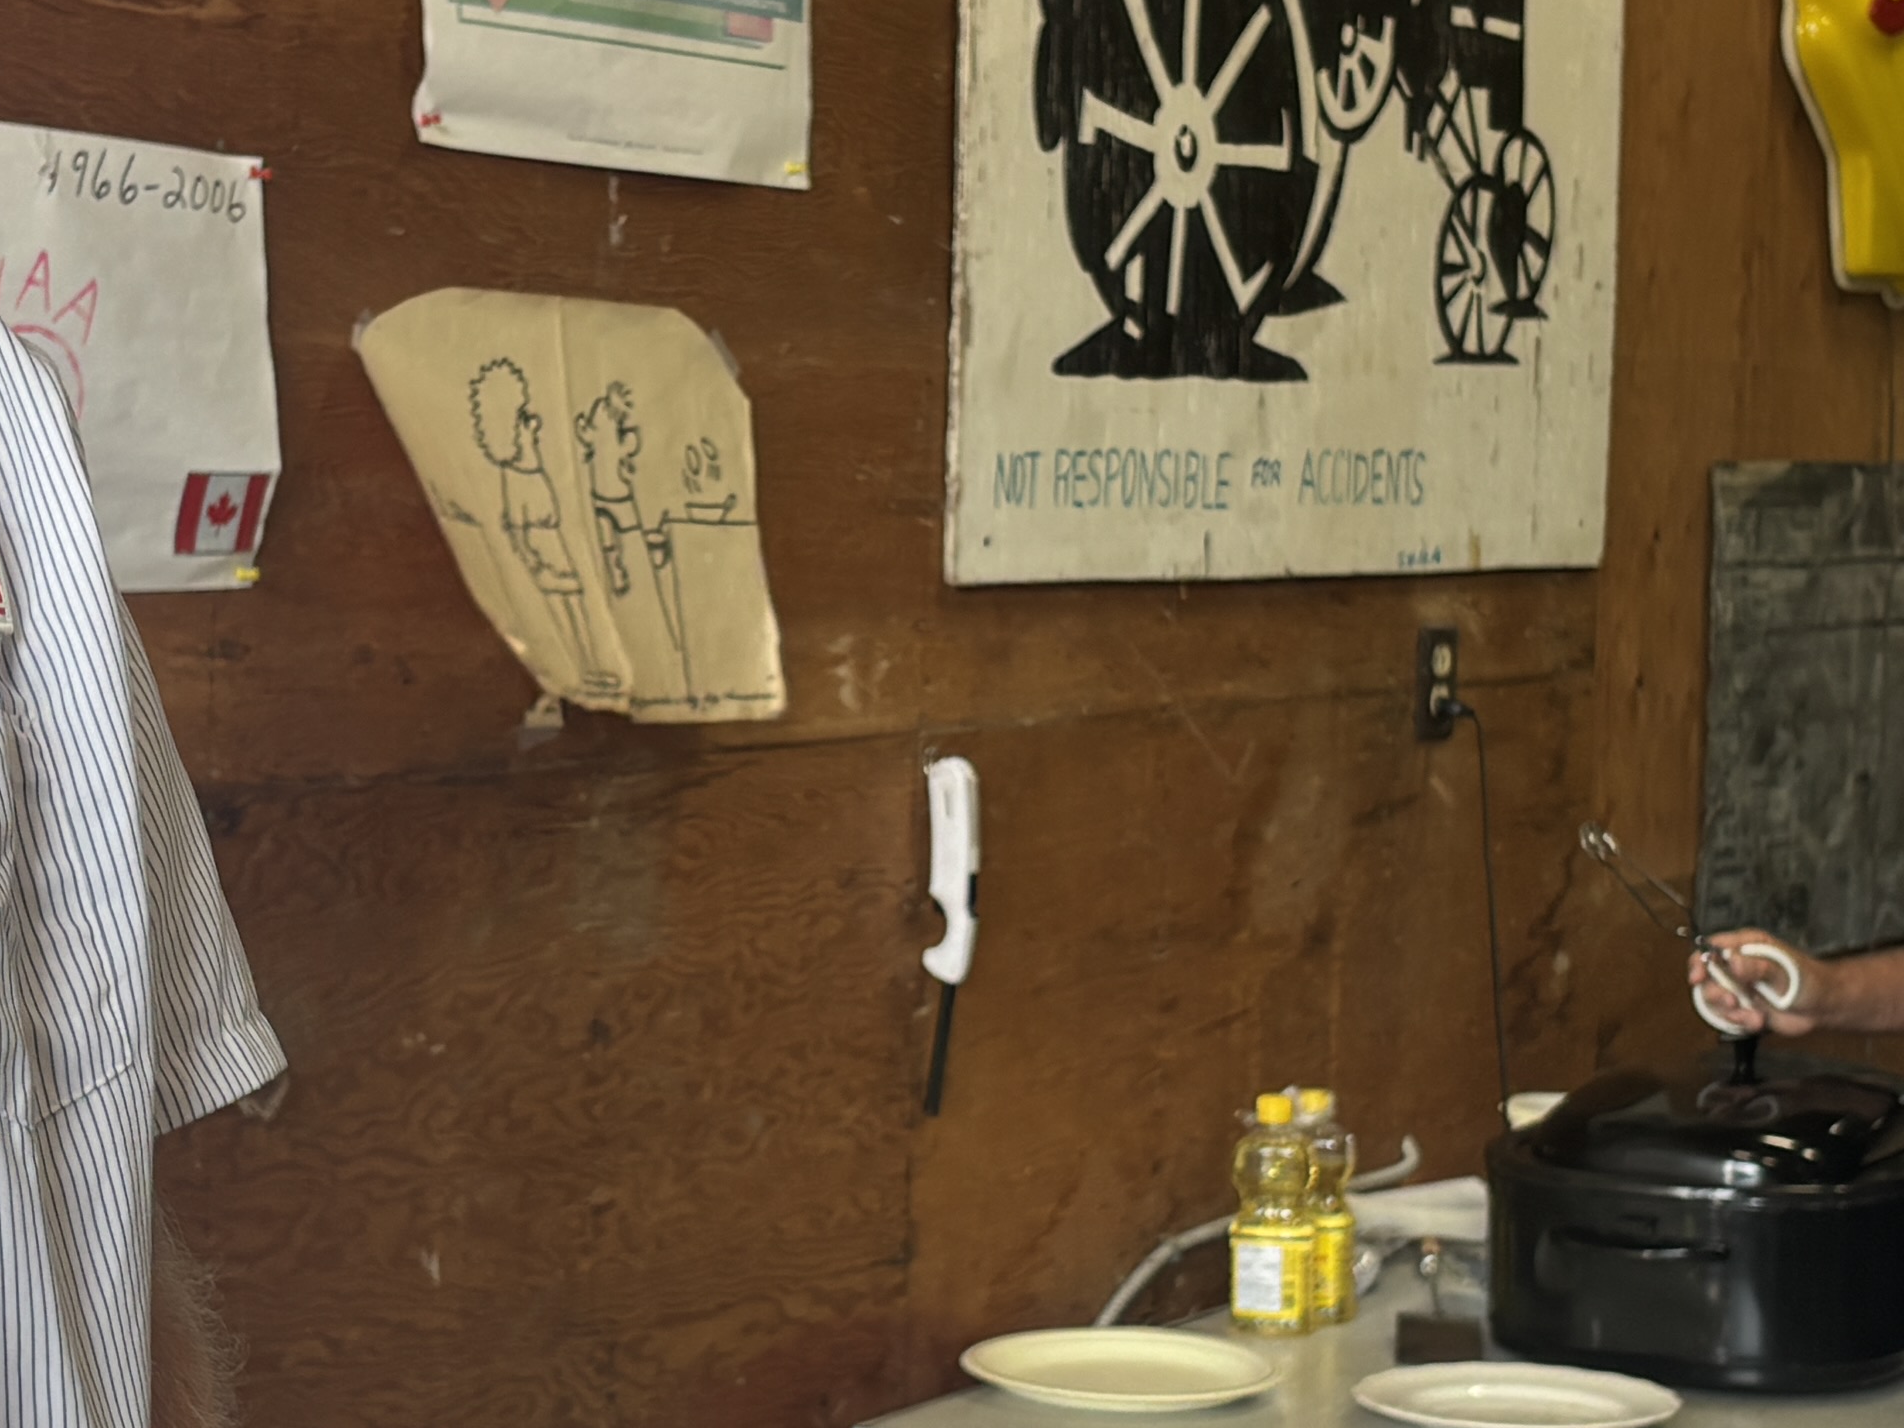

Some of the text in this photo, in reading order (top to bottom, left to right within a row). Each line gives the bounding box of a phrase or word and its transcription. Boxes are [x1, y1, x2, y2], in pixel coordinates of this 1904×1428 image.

[39, 149, 247, 223] 1966-2006
[995, 447, 1426, 510] NOT RESPONSIBLE FOR ACCIDENTS
